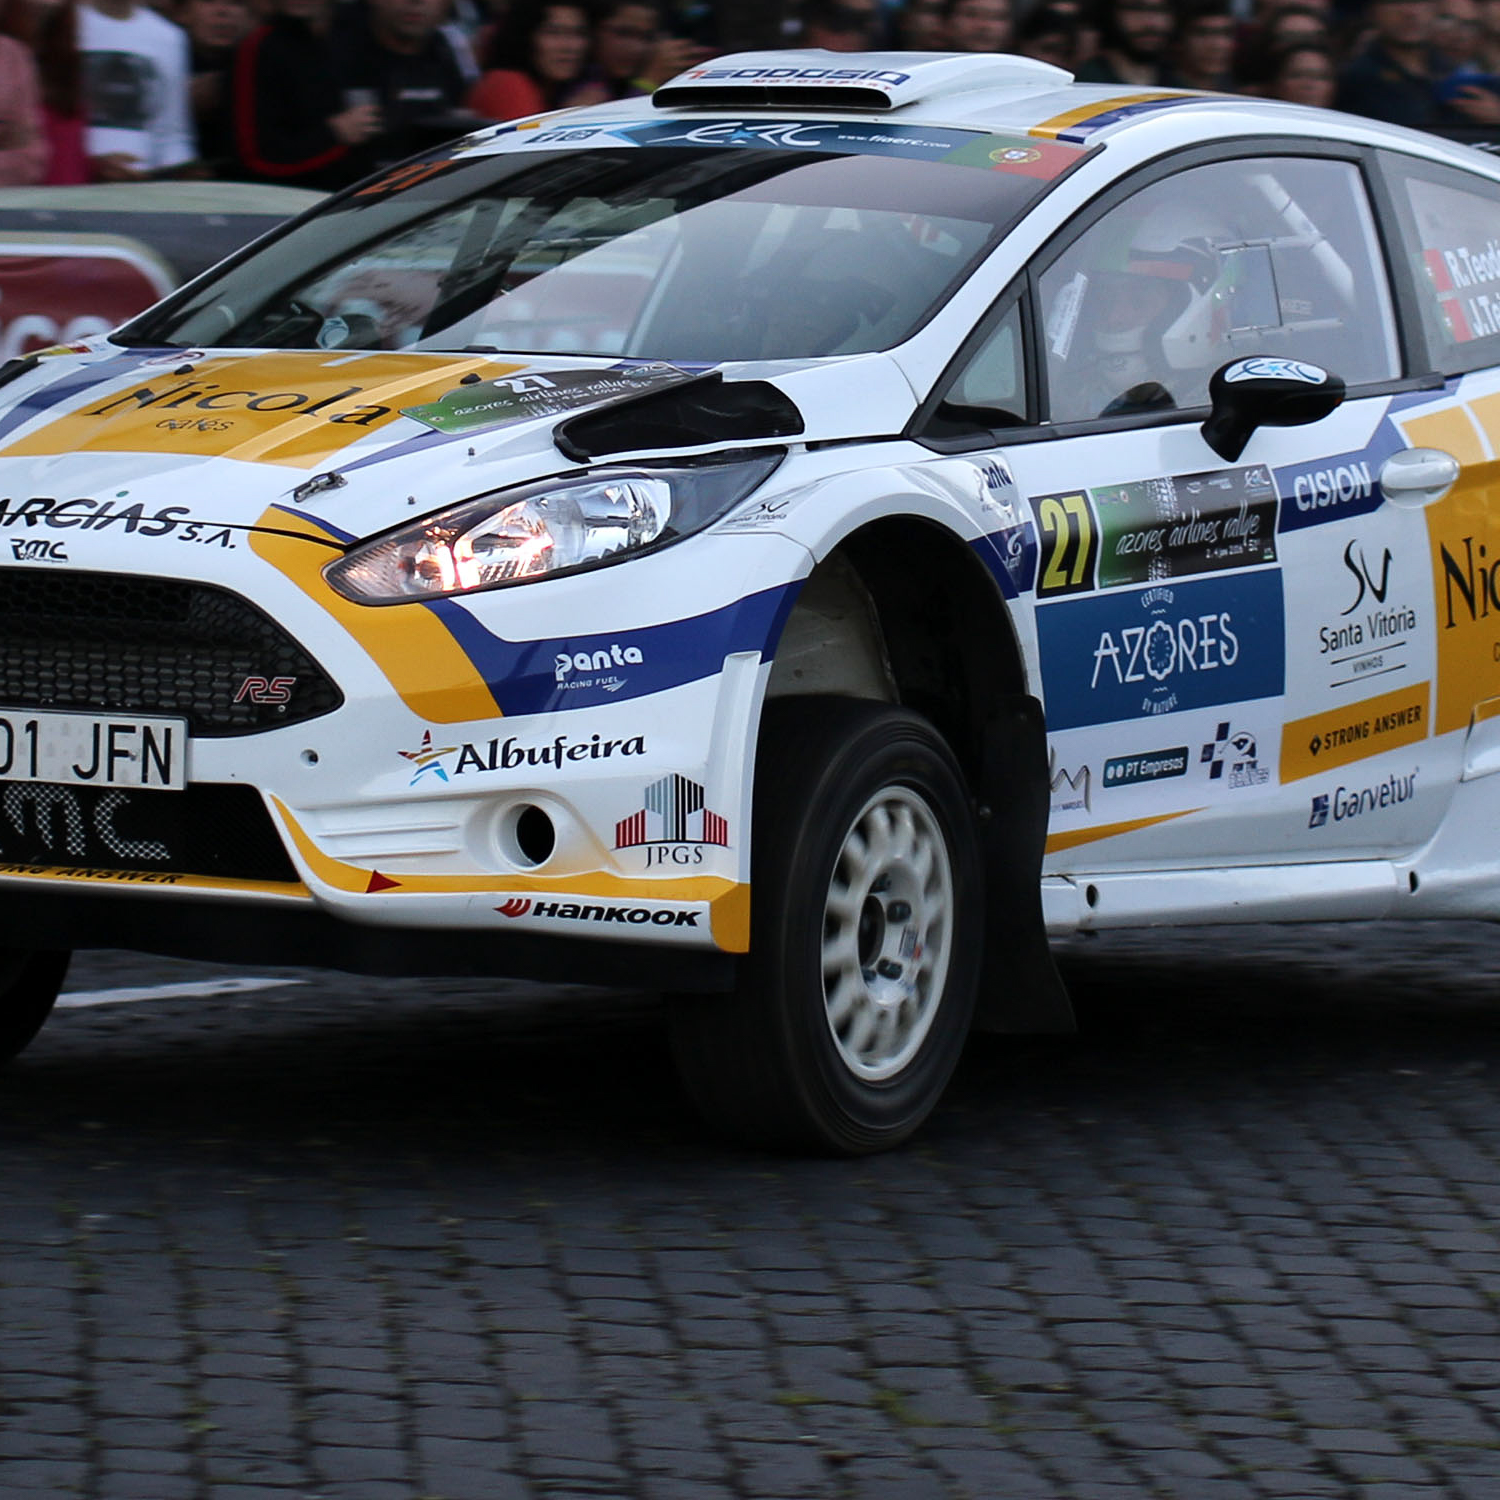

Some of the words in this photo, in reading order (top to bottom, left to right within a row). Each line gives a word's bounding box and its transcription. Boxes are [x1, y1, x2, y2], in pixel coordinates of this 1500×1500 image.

[83, 380, 388, 427] Nicola
[454, 399, 514, 417] azores
[519, 384, 583, 404] airlines
[587, 377, 633, 393] rallye
[493, 374, 557, 394] 27
[1293, 462, 1372, 512] CISION
[1041, 496, 1092, 590] 27
[1115, 528, 1166, 555] azores
[1168, 506, 1221, 547] airlines
[1222, 499, 1260, 546] rallye
[1091, 611, 1239, 689] AZORES
[1319, 622, 1363, 654] Santa
[1366, 604, 1416, 640] Vitória
[554, 644, 644, 681] panta
[557, 680, 593, 690] RACING
[595, 675, 620, 687] FUEL
[233, 676, 298, 704] RS
[1323, 721, 1371, 751] STRONG
[1373, 705, 1422, 734] ANSWER
[72, 723, 173, 786] JFN
[454, 733, 647, 775] Albufeira
[1124, 762, 1140, 778] PT
[1333, 774, 1417, 822] Garvetur
[644, 844, 704, 868] JPGS
